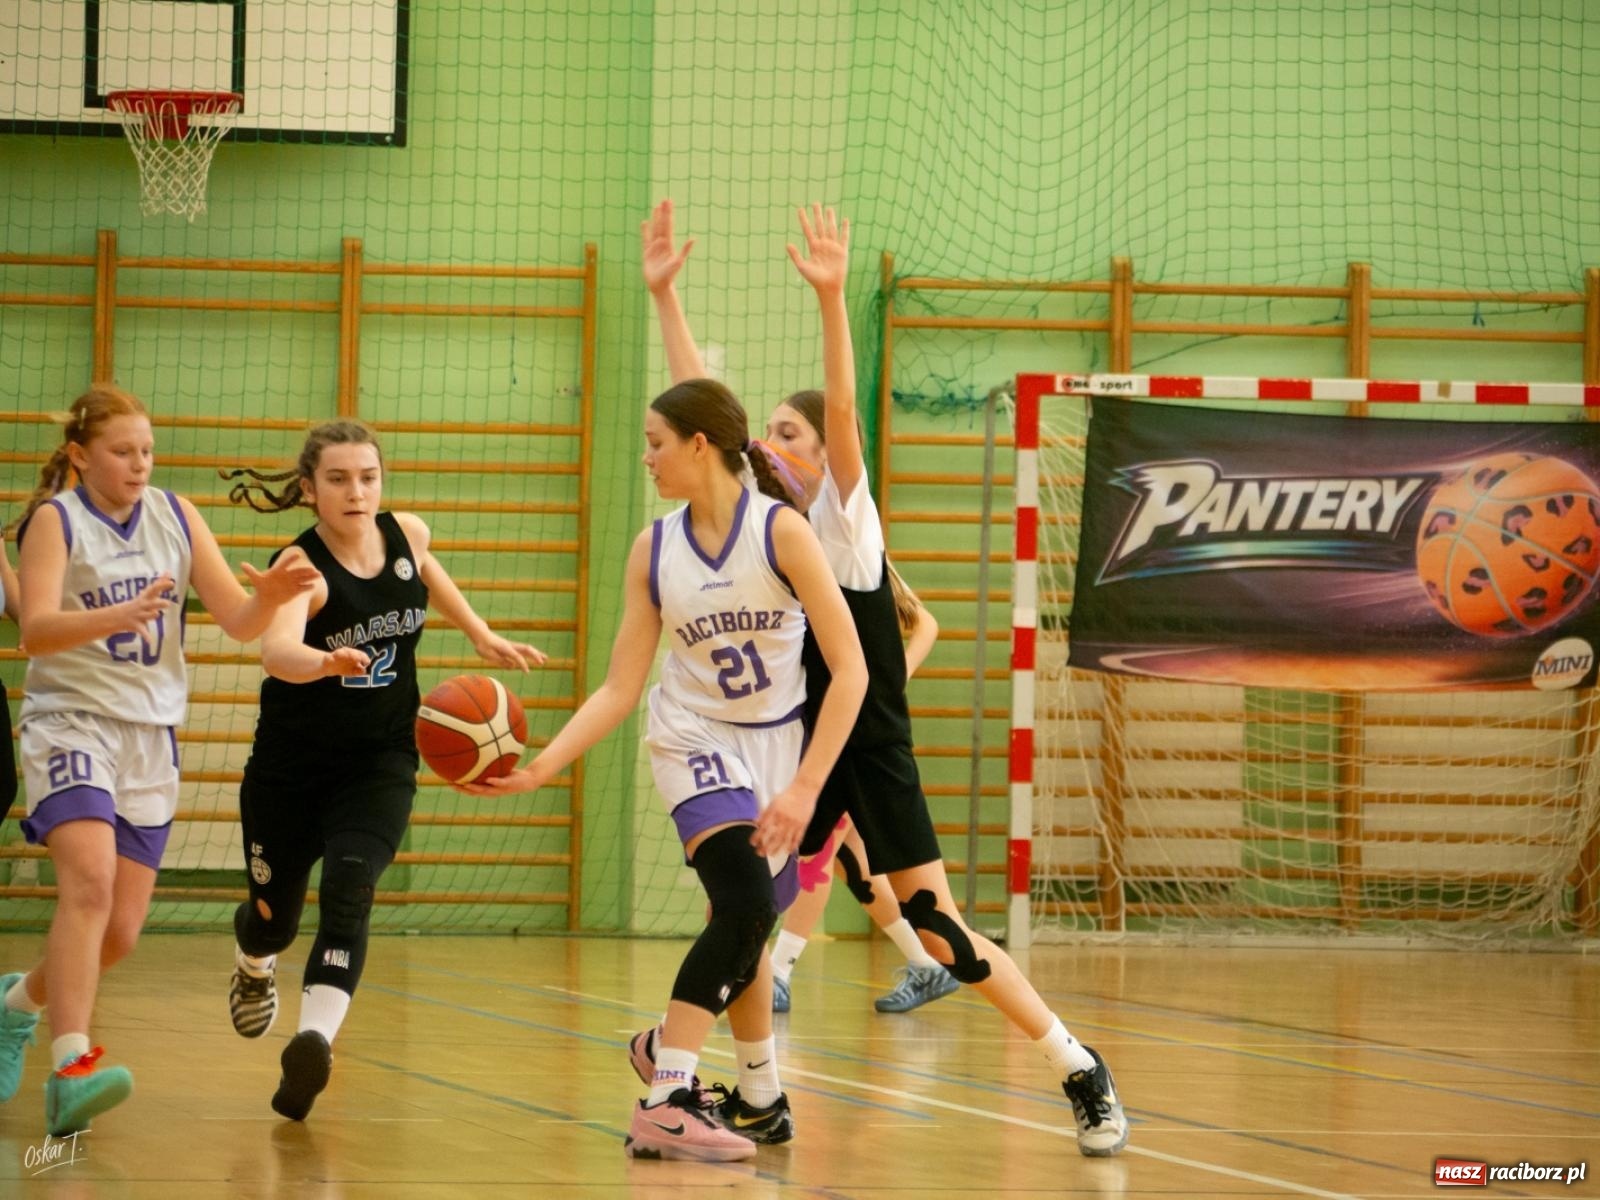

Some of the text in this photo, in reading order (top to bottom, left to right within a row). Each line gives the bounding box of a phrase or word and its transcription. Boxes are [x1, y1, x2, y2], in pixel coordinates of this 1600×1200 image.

[1100, 380, 1133, 391] sport
[1118, 464, 1424, 560] PANTERY
[80, 572, 178, 610] RACIB
[676, 606, 786, 648] RACIBÓRZ
[711, 639, 772, 700] 21
[1535, 655, 1592, 676] MINI
[48, 748, 92, 788] 20
[688, 752, 731, 790] 21
[330, 949, 350, 969] NBA
